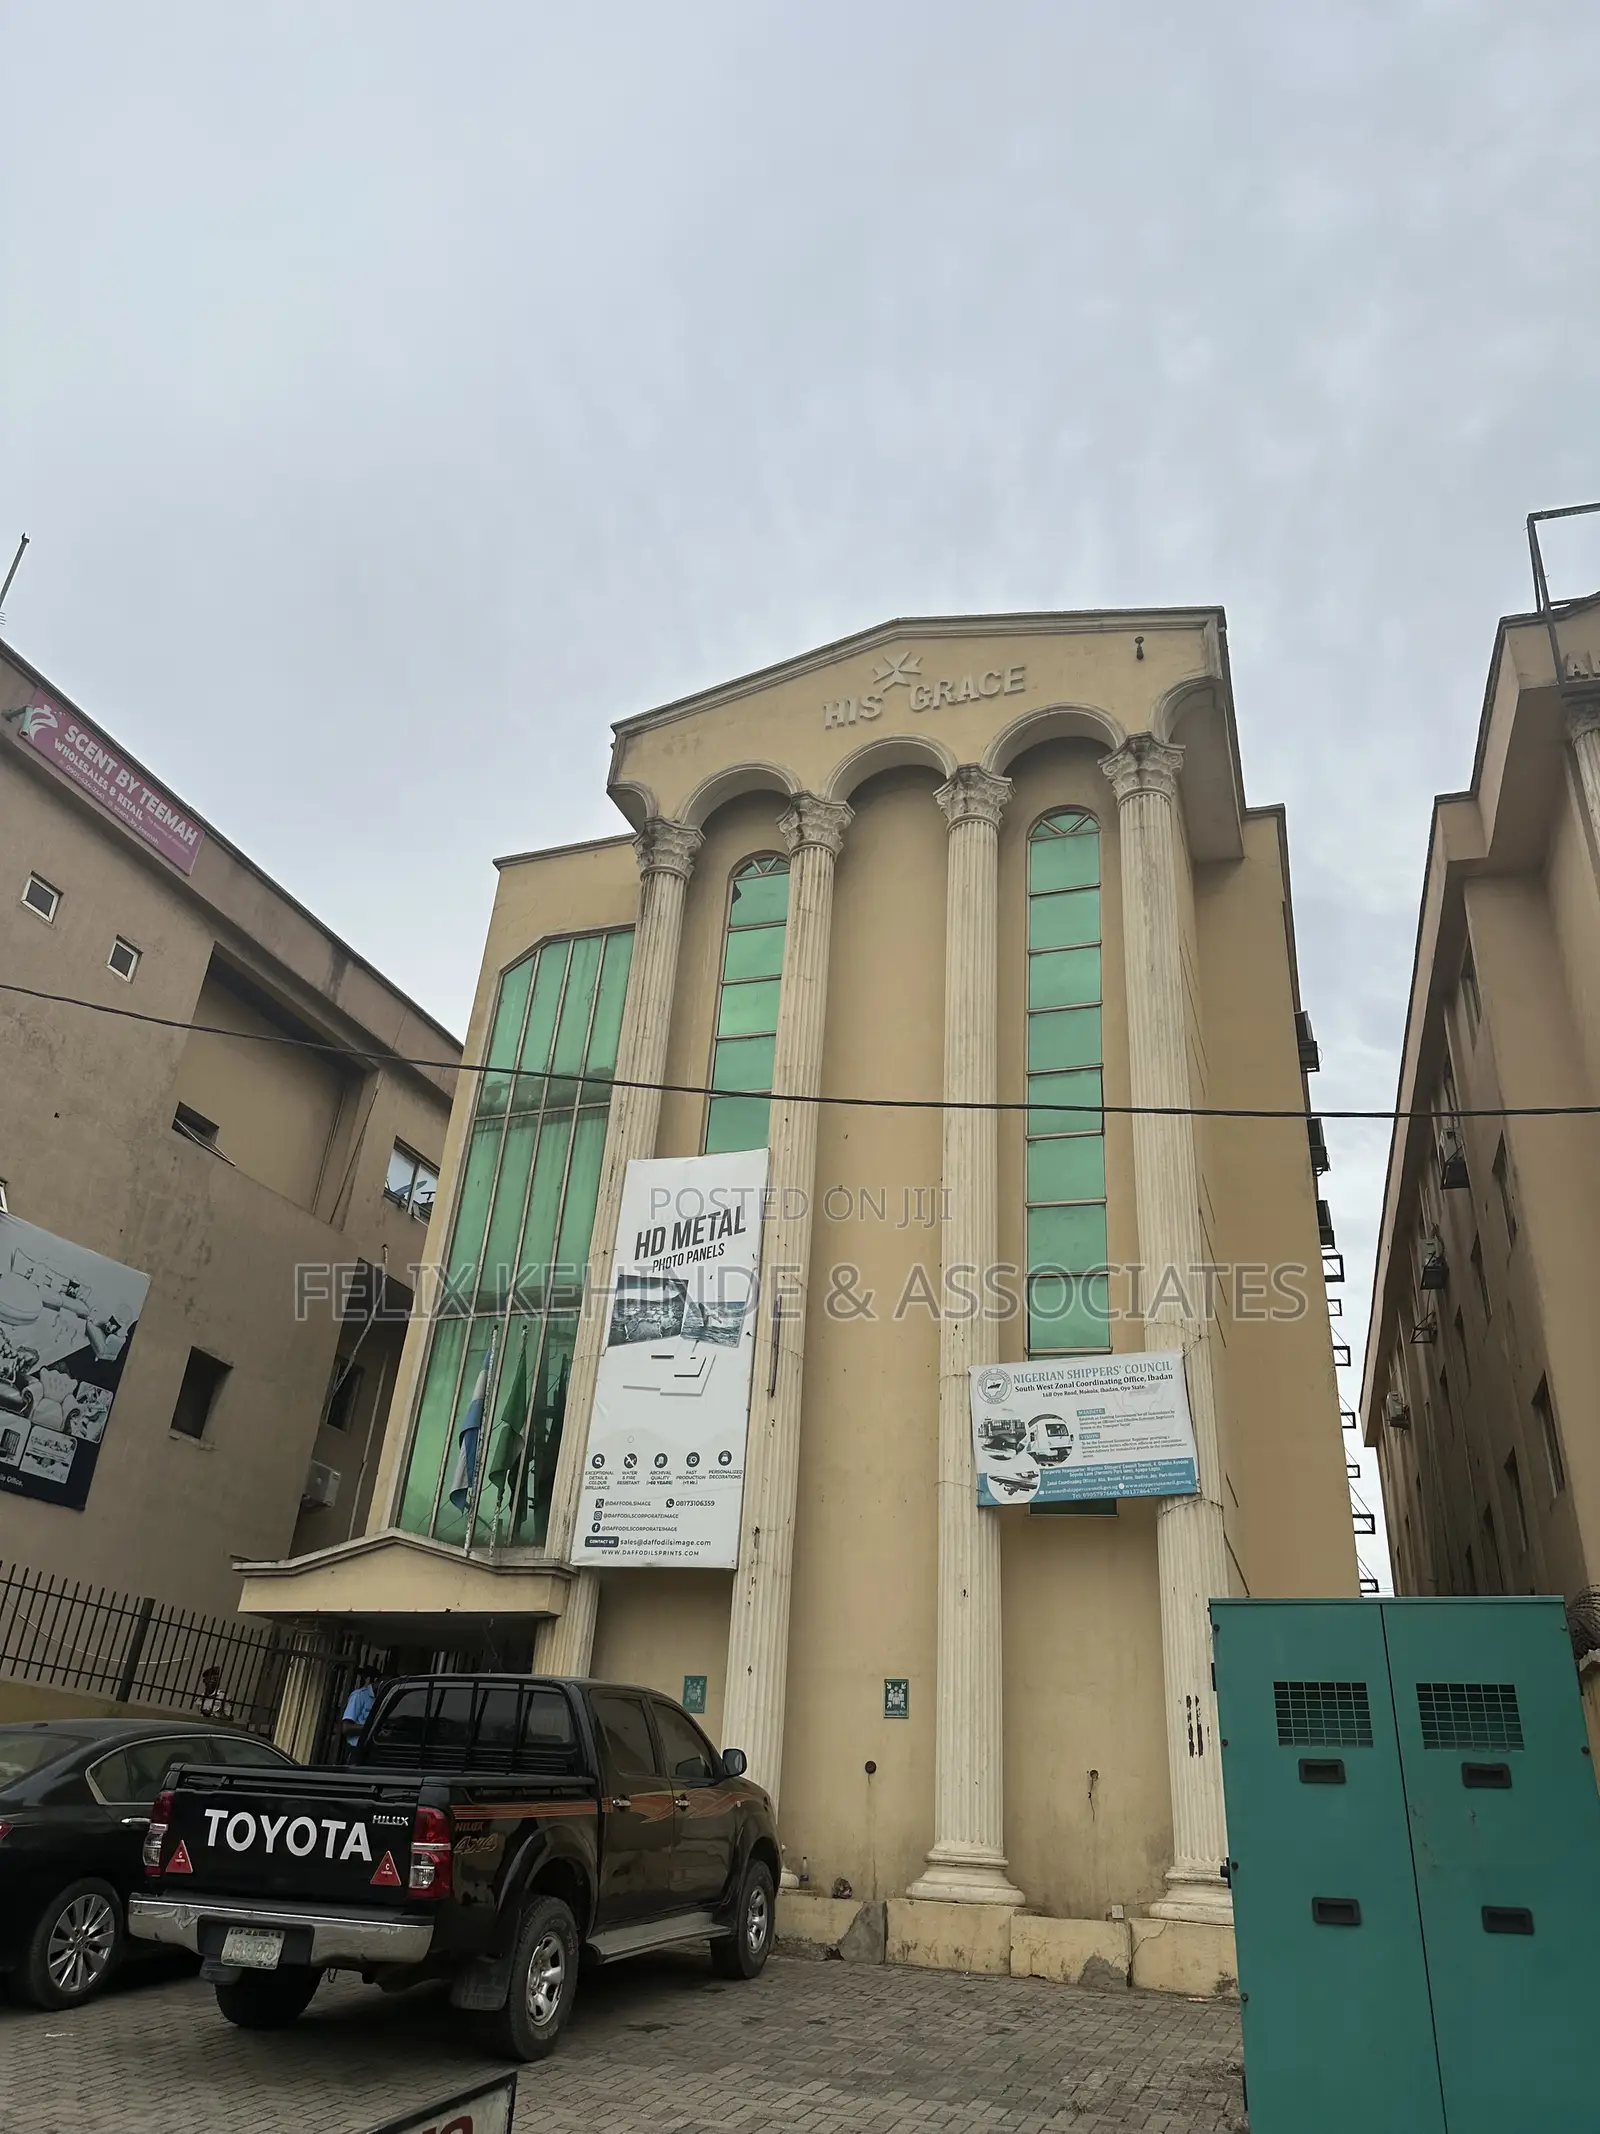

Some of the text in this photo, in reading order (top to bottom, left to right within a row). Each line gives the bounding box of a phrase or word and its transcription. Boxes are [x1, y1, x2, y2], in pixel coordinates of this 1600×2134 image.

[823, 664, 1027, 730] HIS GRACE
[54, 737, 108, 791] WHOLESALES
[117, 793, 144, 821] RETAIL
[64, 724, 118, 776] SCENT
[115, 768, 140, 795] BY
[140, 787, 199, 846] TEEMAH
[634, 1205, 747, 1261] HD METAL
[652, 1242, 725, 1273] PHOTO PANELS
[1013, 1369, 1064, 1384] NIGERIAN
[1125, 1361, 1173, 1374] COUNCIL
[1014, 1384, 1035, 1393] South
[1036, 1382, 1054, 1391] West
[1054, 1380, 1075, 1389] Zonal
[1076, 1377, 1123, 1388] Coordinating
[1148, 1372, 1173, 1382] Ibadan
[620, 1539, 711, 1547] sales@daffodilsimage.com
[204, 1808, 373, 1862] TOYOTA
[372, 1814, 409, 1826] HILUX
